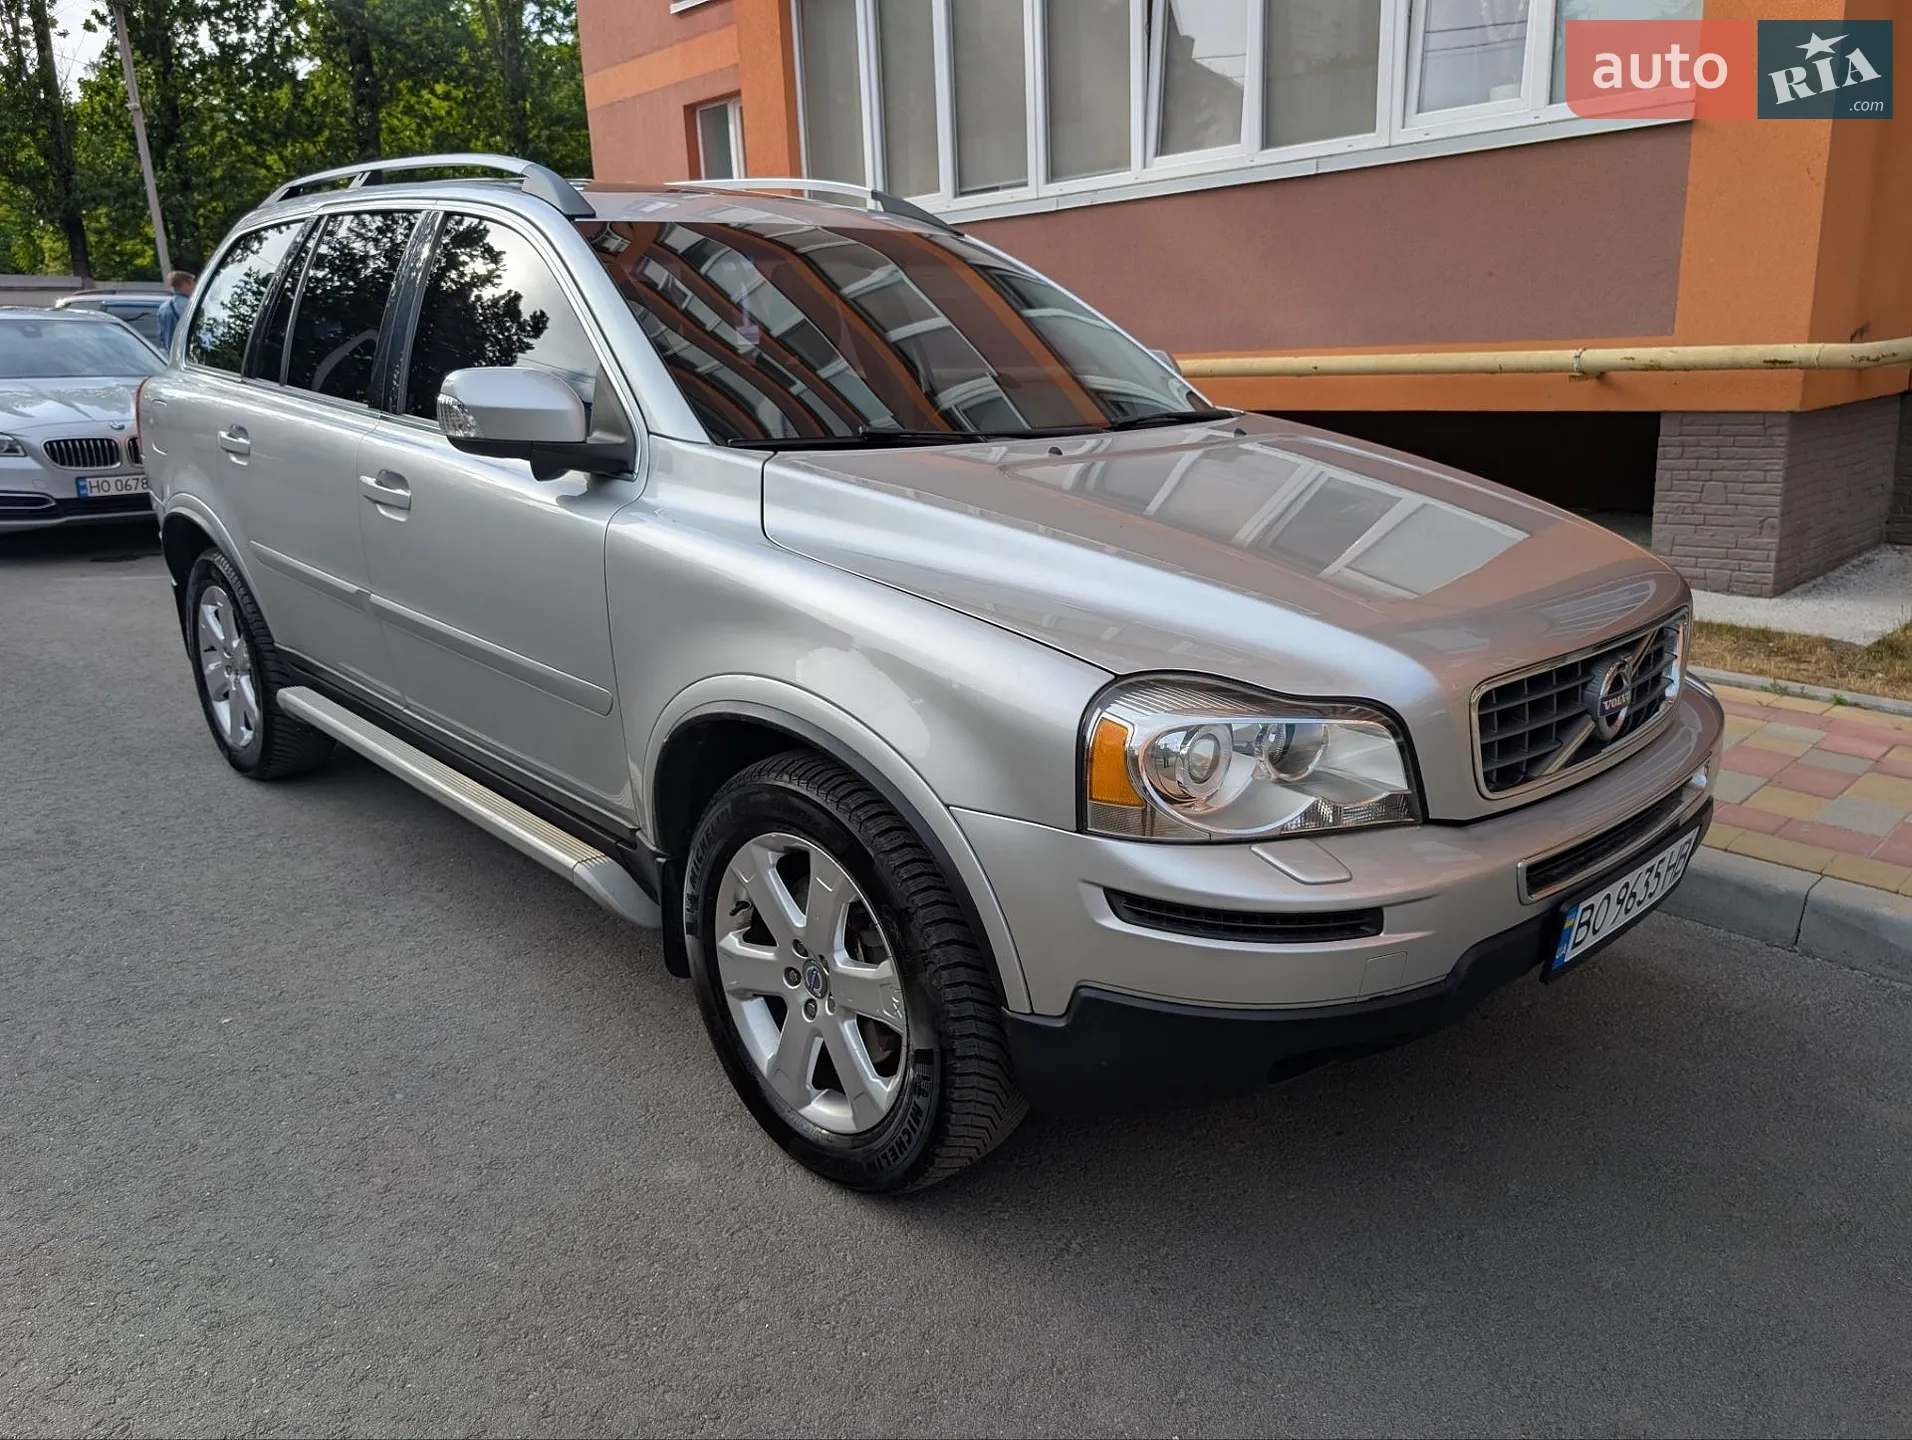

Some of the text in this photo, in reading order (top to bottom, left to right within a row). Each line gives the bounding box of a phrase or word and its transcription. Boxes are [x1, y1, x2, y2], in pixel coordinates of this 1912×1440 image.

[88, 479, 111, 494] HO
[114, 477, 149, 492] 0678
[1570, 837, 1692, 950] BO 9635 HB
[865, 1101, 924, 1173] MICHELIN
